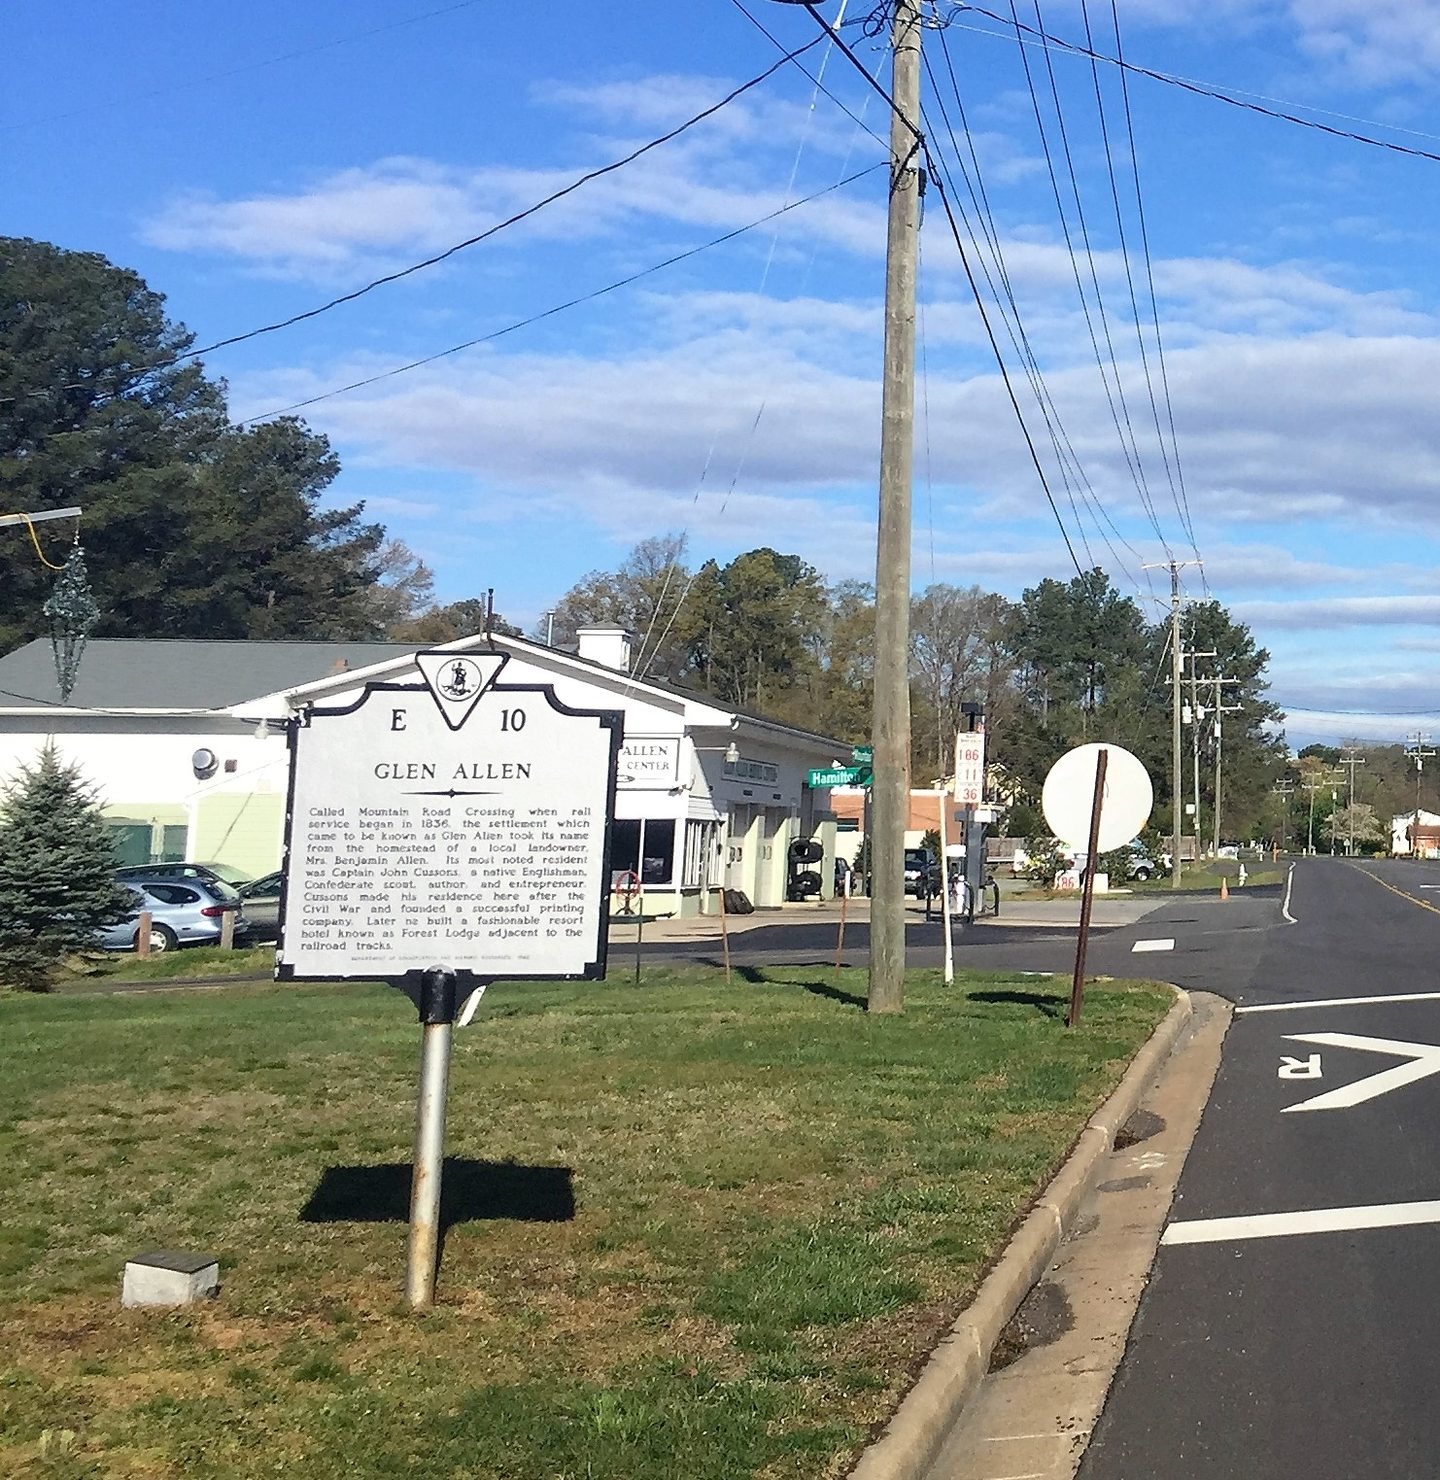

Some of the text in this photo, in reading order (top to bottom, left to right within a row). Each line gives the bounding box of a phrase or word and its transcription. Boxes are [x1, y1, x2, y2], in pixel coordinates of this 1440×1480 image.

[391, 708, 526, 731] E 10
[622, 746, 668, 756] ALLEN
[627, 761, 669, 770] CENTER
[374, 763, 531, 779] GLEN ALLEN
[310, 807, 591, 818] Called Mountain Road Crossing when rail
[309, 820, 349, 829] service
[359, 820, 393, 831] began
[402, 820, 412, 829] in
[463, 819, 480, 828] the
[489, 819, 547, 828] settlement
[557, 819, 590, 828] which
[307, 831, 588, 841] came to be known as Glen Allen took its name
[307, 844, 333, 853] from
[346, 844, 364, 853] the
[376, 844, 435, 853] homestead
[447, 844, 459, 853] of
[471, 845, 477, 853] a
[489, 844, 516, 853] local
[335, 856, 388, 867] Benjamin
[447, 856, 459, 865] Its
[468, 856, 494, 865] most
[503, 856, 533, 865] noted
[543, 855, 587, 865] resident
[305, 869, 325, 877] was
[332, 868, 374, 879] Captain
[380, 868, 408, 877] John
[471, 869, 478, 877] a
[483, 868, 516, 877] native
[305, 880, 373, 889] Confederate
[481, 880, 500, 889] and
[304, 892, 584, 901] Cussons made his residence here after the
[303, 904, 329, 913] Civil
[339, 904, 361, 913] War
[371, 904, 391, 913] and
[401, 904, 445, 913] founded
[473, 904, 530, 913] successful
[540, 904, 584, 915] printing
[367, 916, 396, 925] Later
[406, 916, 418, 925] he
[427, 916, 452, 925] built
[478, 916, 540, 925] fashionable
[549, 916, 584, 925] resort
[301, 928, 582, 939] hotel known as Forest Lodge adjacent to the
[301, 941, 346, 950] railroad
